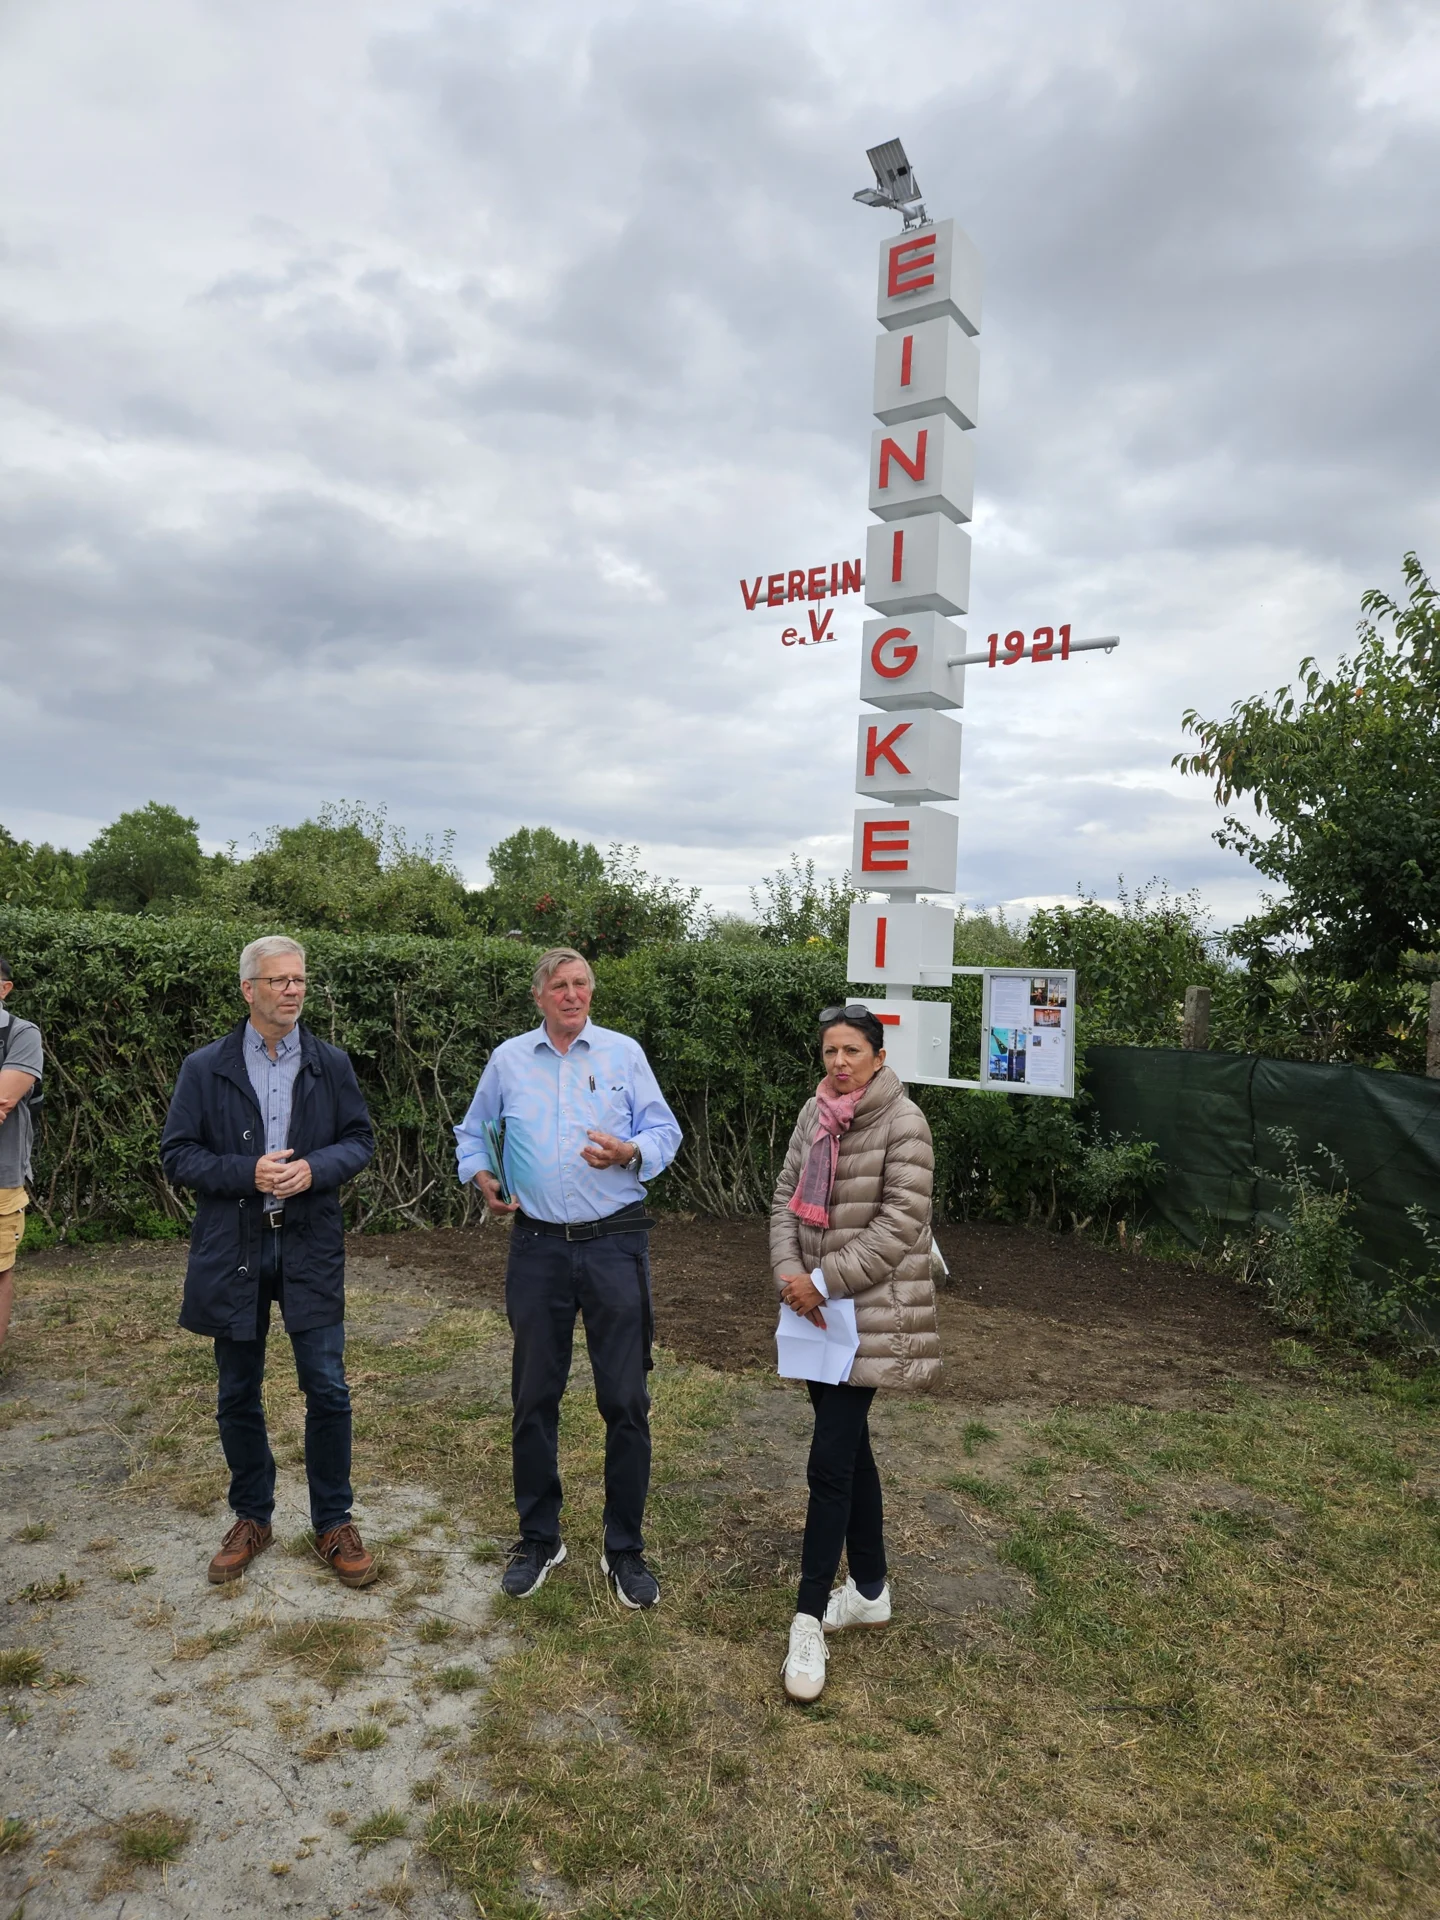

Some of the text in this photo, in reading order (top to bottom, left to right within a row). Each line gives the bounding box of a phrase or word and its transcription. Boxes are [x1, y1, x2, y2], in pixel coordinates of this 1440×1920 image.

[739, 558, 861, 610] VEREIN
[781, 608, 834, 646] e.V.
[862, 234, 936, 1027] EINIGKEI
[987, 624, 1071, 667] 1921
